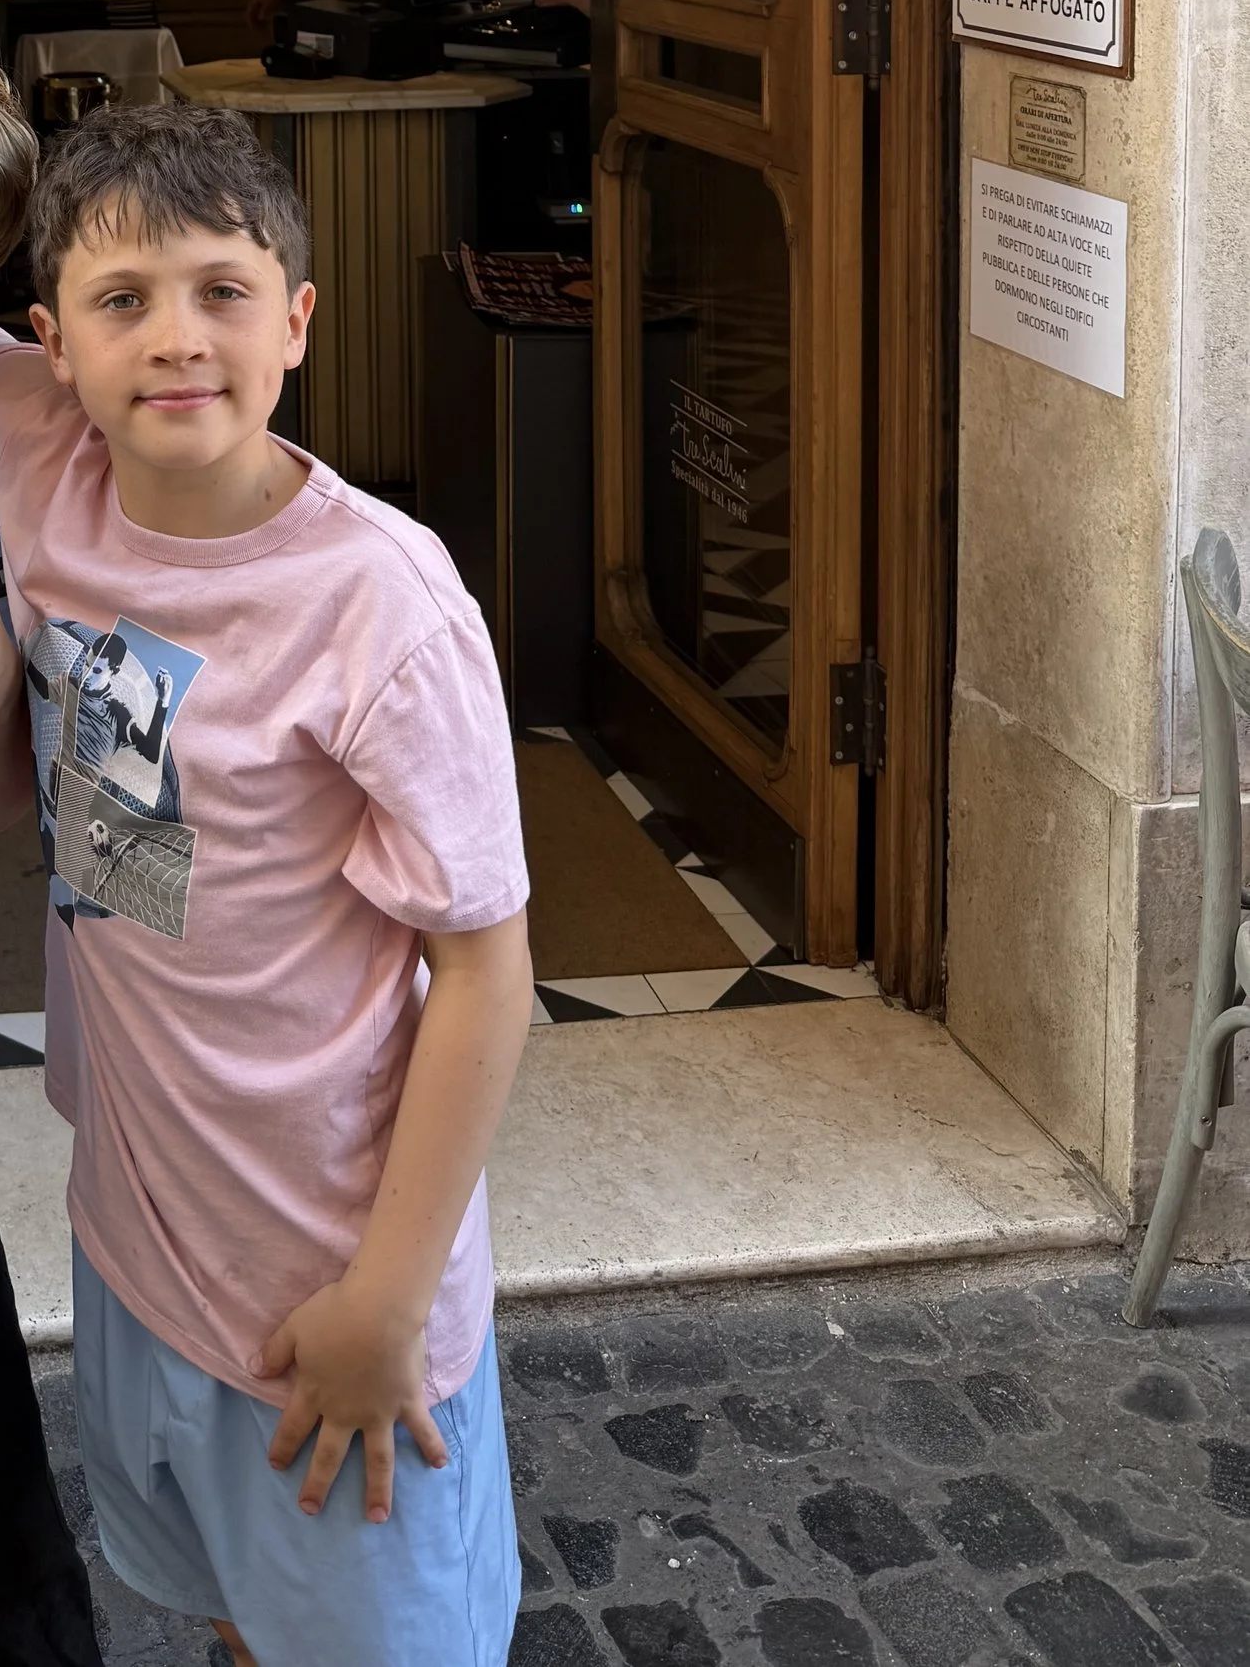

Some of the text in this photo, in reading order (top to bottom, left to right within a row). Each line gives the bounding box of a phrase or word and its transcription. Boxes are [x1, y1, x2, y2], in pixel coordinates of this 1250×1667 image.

[981, 184, 1113, 236] SI PREGA DI EVITARE SCHIAMAZZI
[988, 208, 997, 221] DI
[999, 213, 1032, 234] PARLARE
[1034, 224, 1046, 238] AD
[1047, 228, 1068, 246] ALTA
[1069, 235, 1092, 253] VOCE
[1094, 243, 1111, 260] NEL
[998, 234, 1092, 278] RISPETTO DELLA QUIETE
[982, 251, 1019, 275] PUBBLICA
[1027, 267, 1051, 288] DELLE
[1052, 277, 1090, 303] PERSONE
[1091, 290, 1110, 309] CHE
[995, 279, 1094, 328] DORMONO NEGLI EDIFICI
[1016, 310, 1069, 342] CIRCOSTANTI
[694, 400, 733, 436] TARTUFO
[726, 497, 748, 524] 1946
